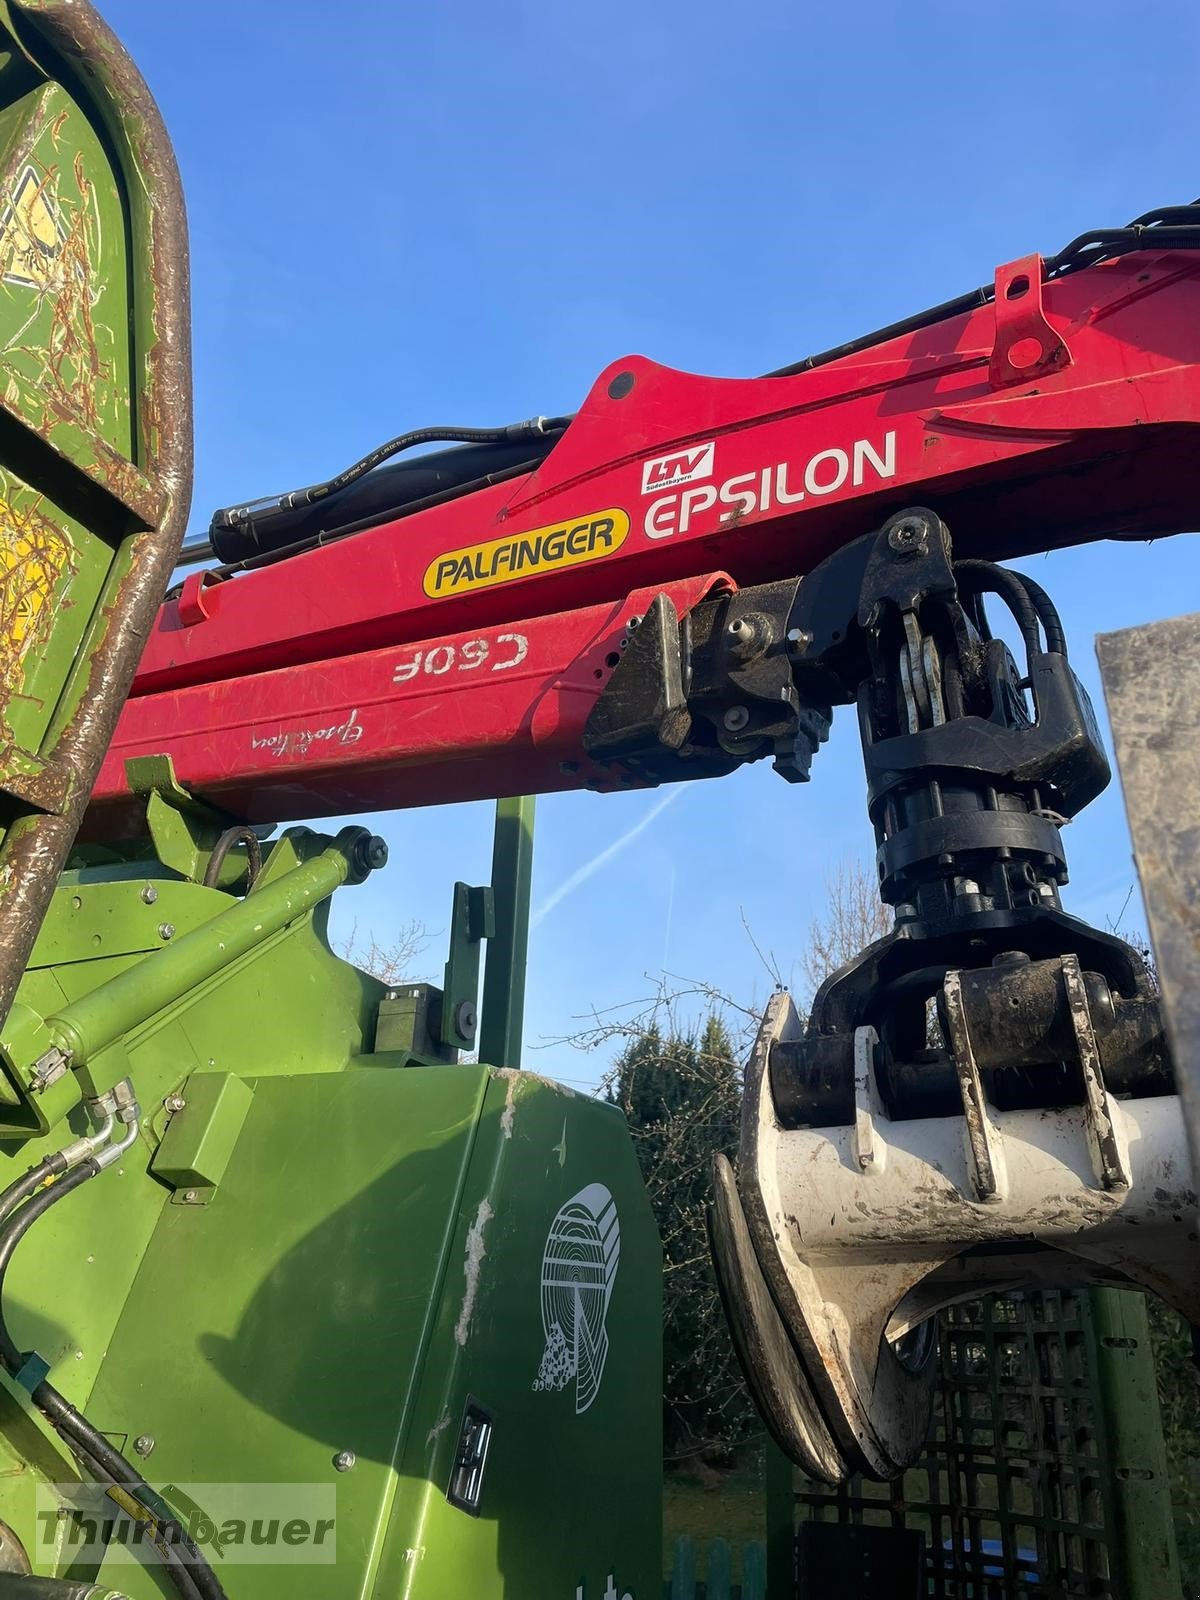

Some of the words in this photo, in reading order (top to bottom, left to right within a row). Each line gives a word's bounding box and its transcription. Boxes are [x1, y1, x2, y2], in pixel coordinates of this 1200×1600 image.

[644, 431, 897, 540] EPSILON
[646, 448, 711, 485] LTV
[435, 517, 614, 591] PALFINGER
[392, 633, 529, 683] C60F
